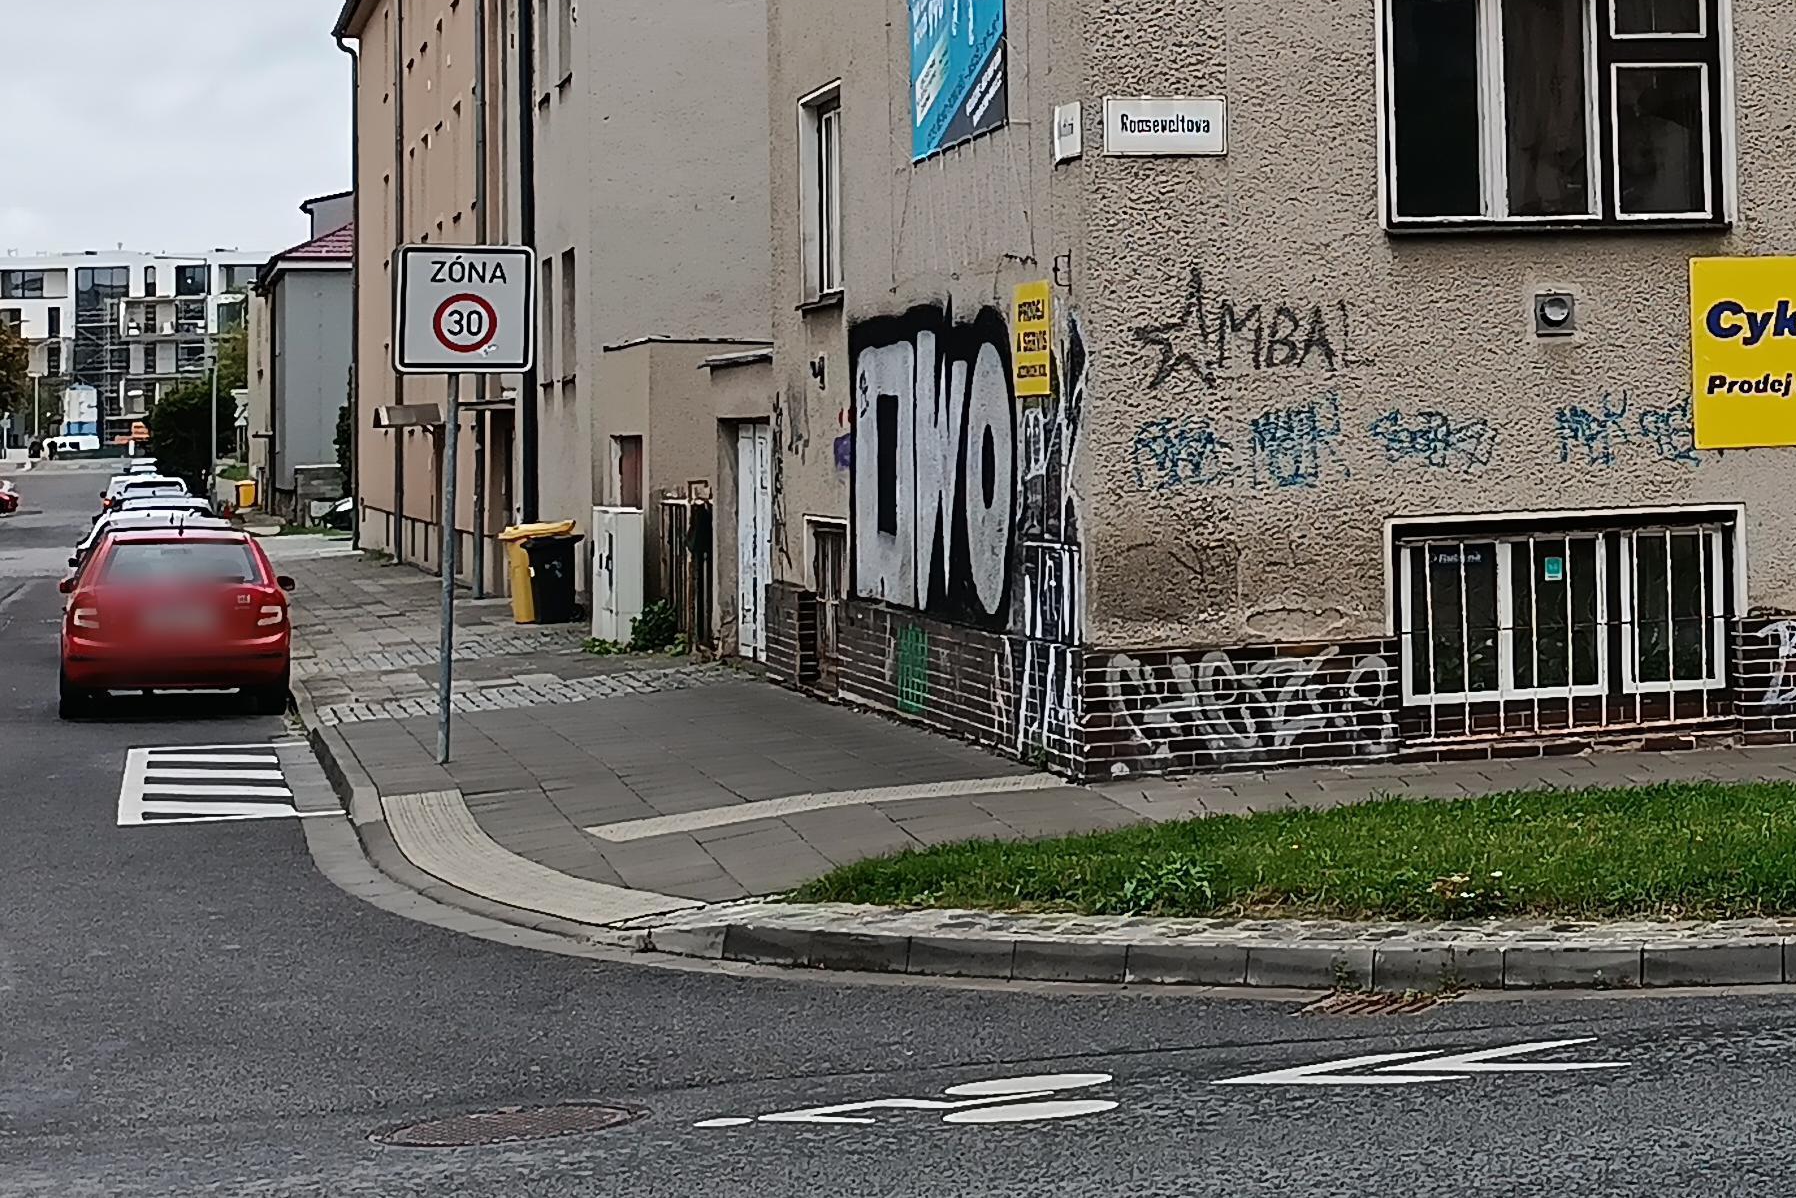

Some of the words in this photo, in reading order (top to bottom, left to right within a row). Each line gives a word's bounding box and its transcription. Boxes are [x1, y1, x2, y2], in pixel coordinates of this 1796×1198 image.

[1120, 113, 1211, 134] Rooseveltova
[430, 255, 507, 284] ZÓNA
[447, 309, 483, 337] 30
[1707, 373, 1793, 397] Prodej
